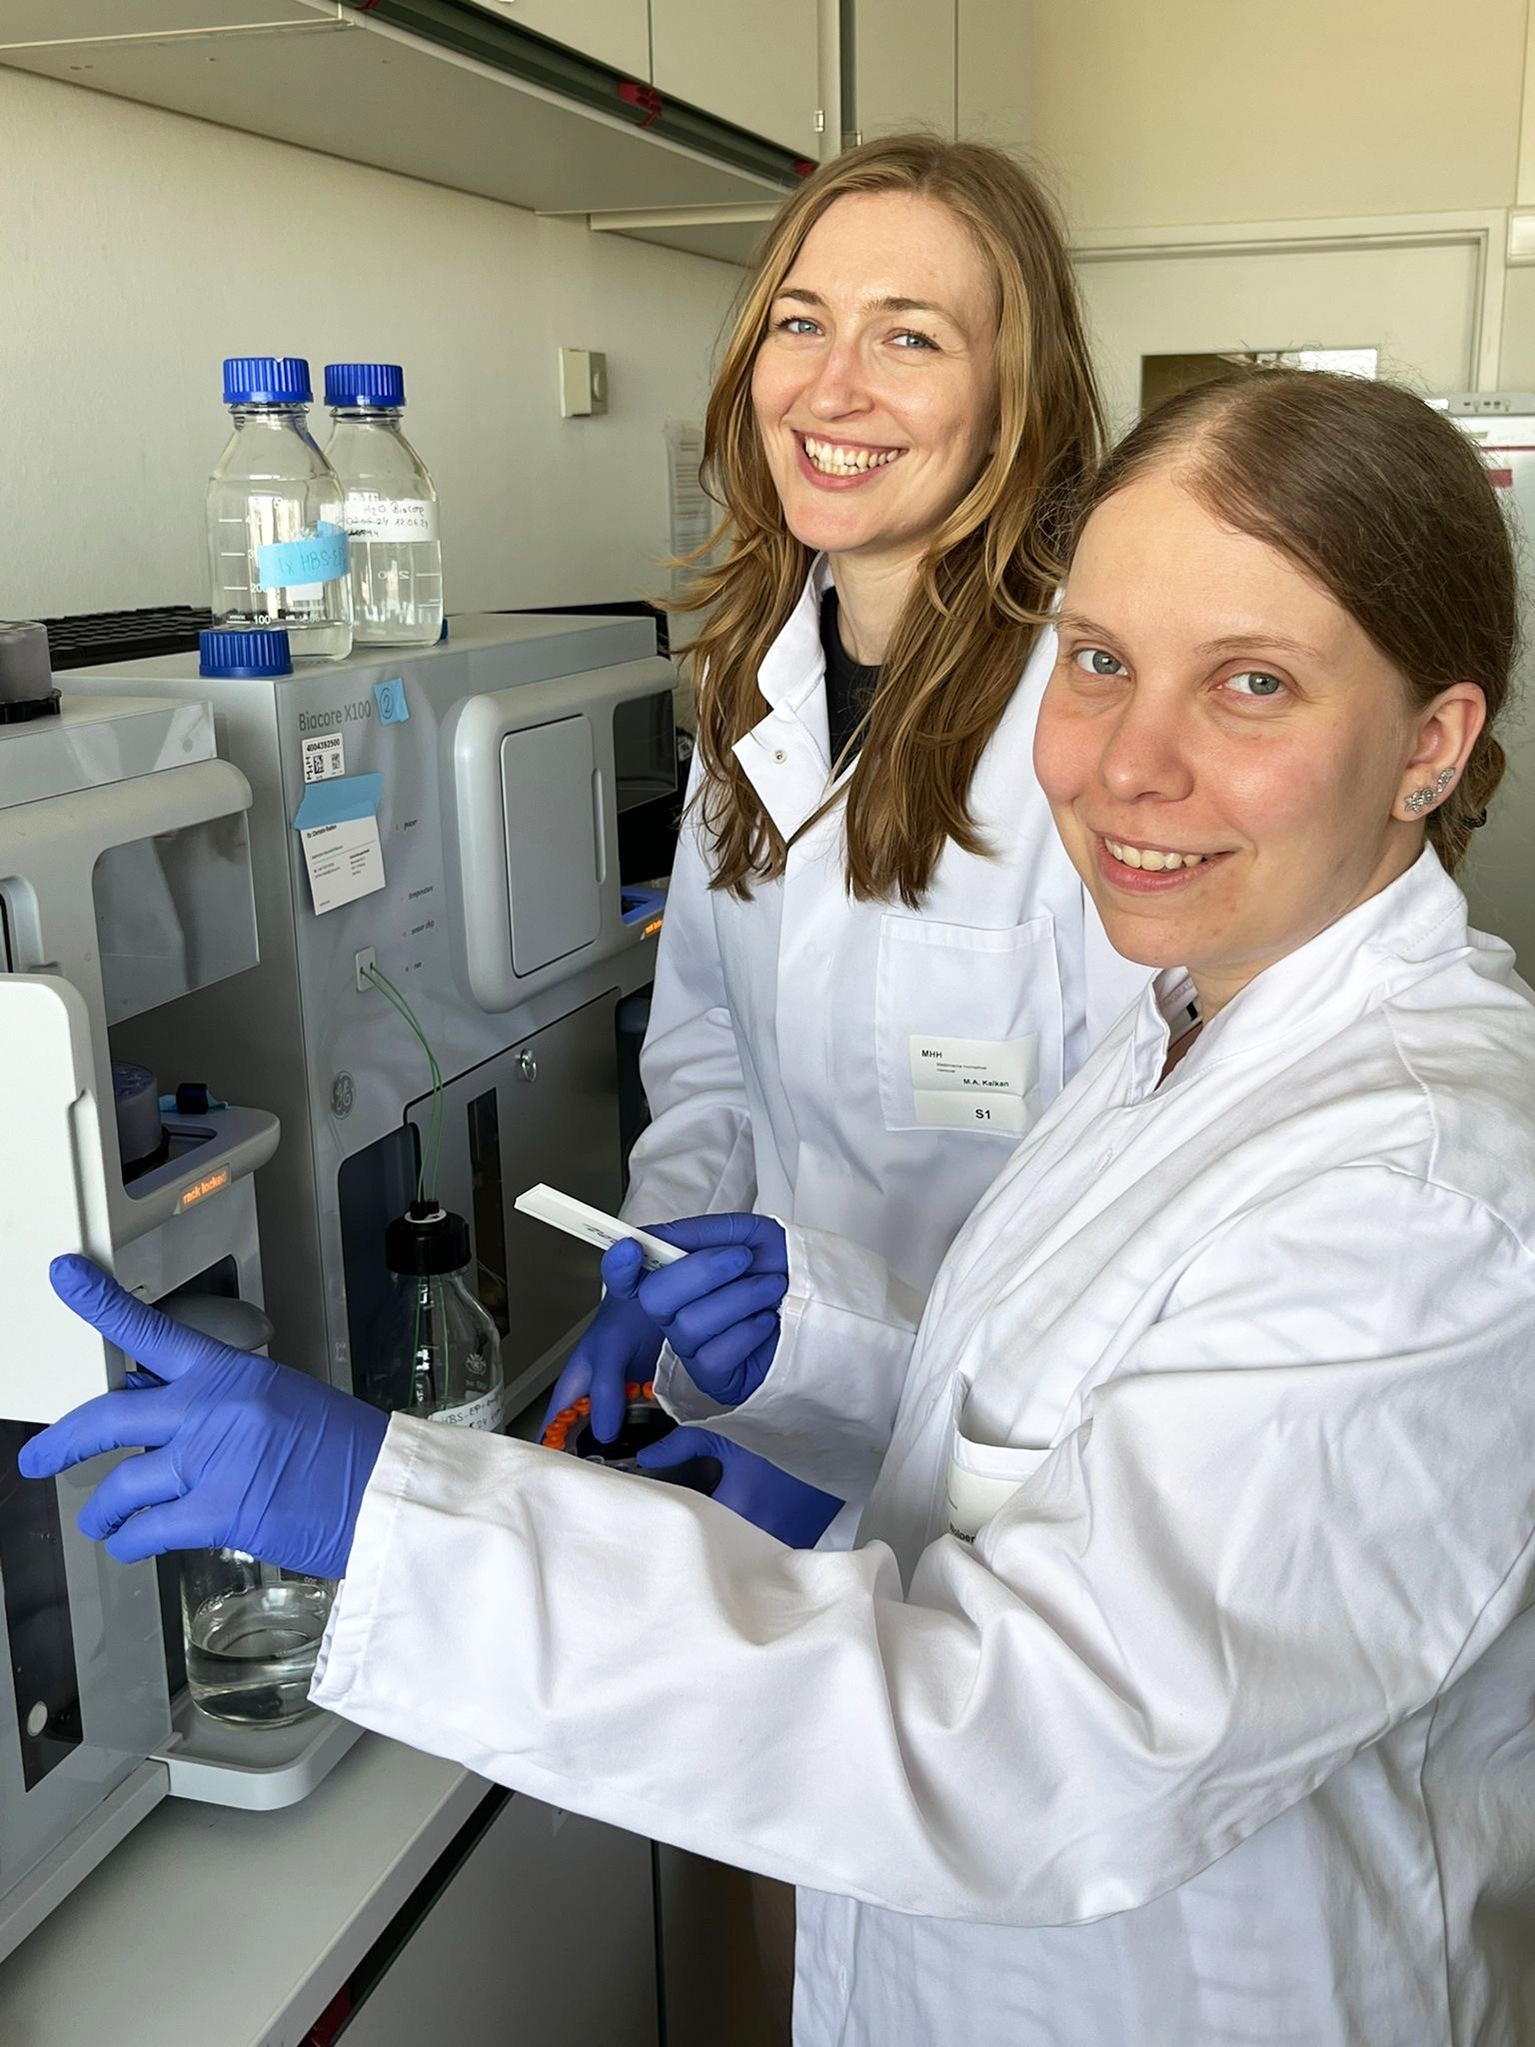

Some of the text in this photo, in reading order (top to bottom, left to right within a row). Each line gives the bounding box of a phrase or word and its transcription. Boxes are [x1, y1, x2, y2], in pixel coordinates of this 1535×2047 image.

[253, 615, 271, 625] 100
[298, 700, 372, 732] Biacore X100
[921, 1049, 943, 1059] MHH
[963, 1078, 980, 1086] M.A.
[975, 1108, 991, 1120] S1
